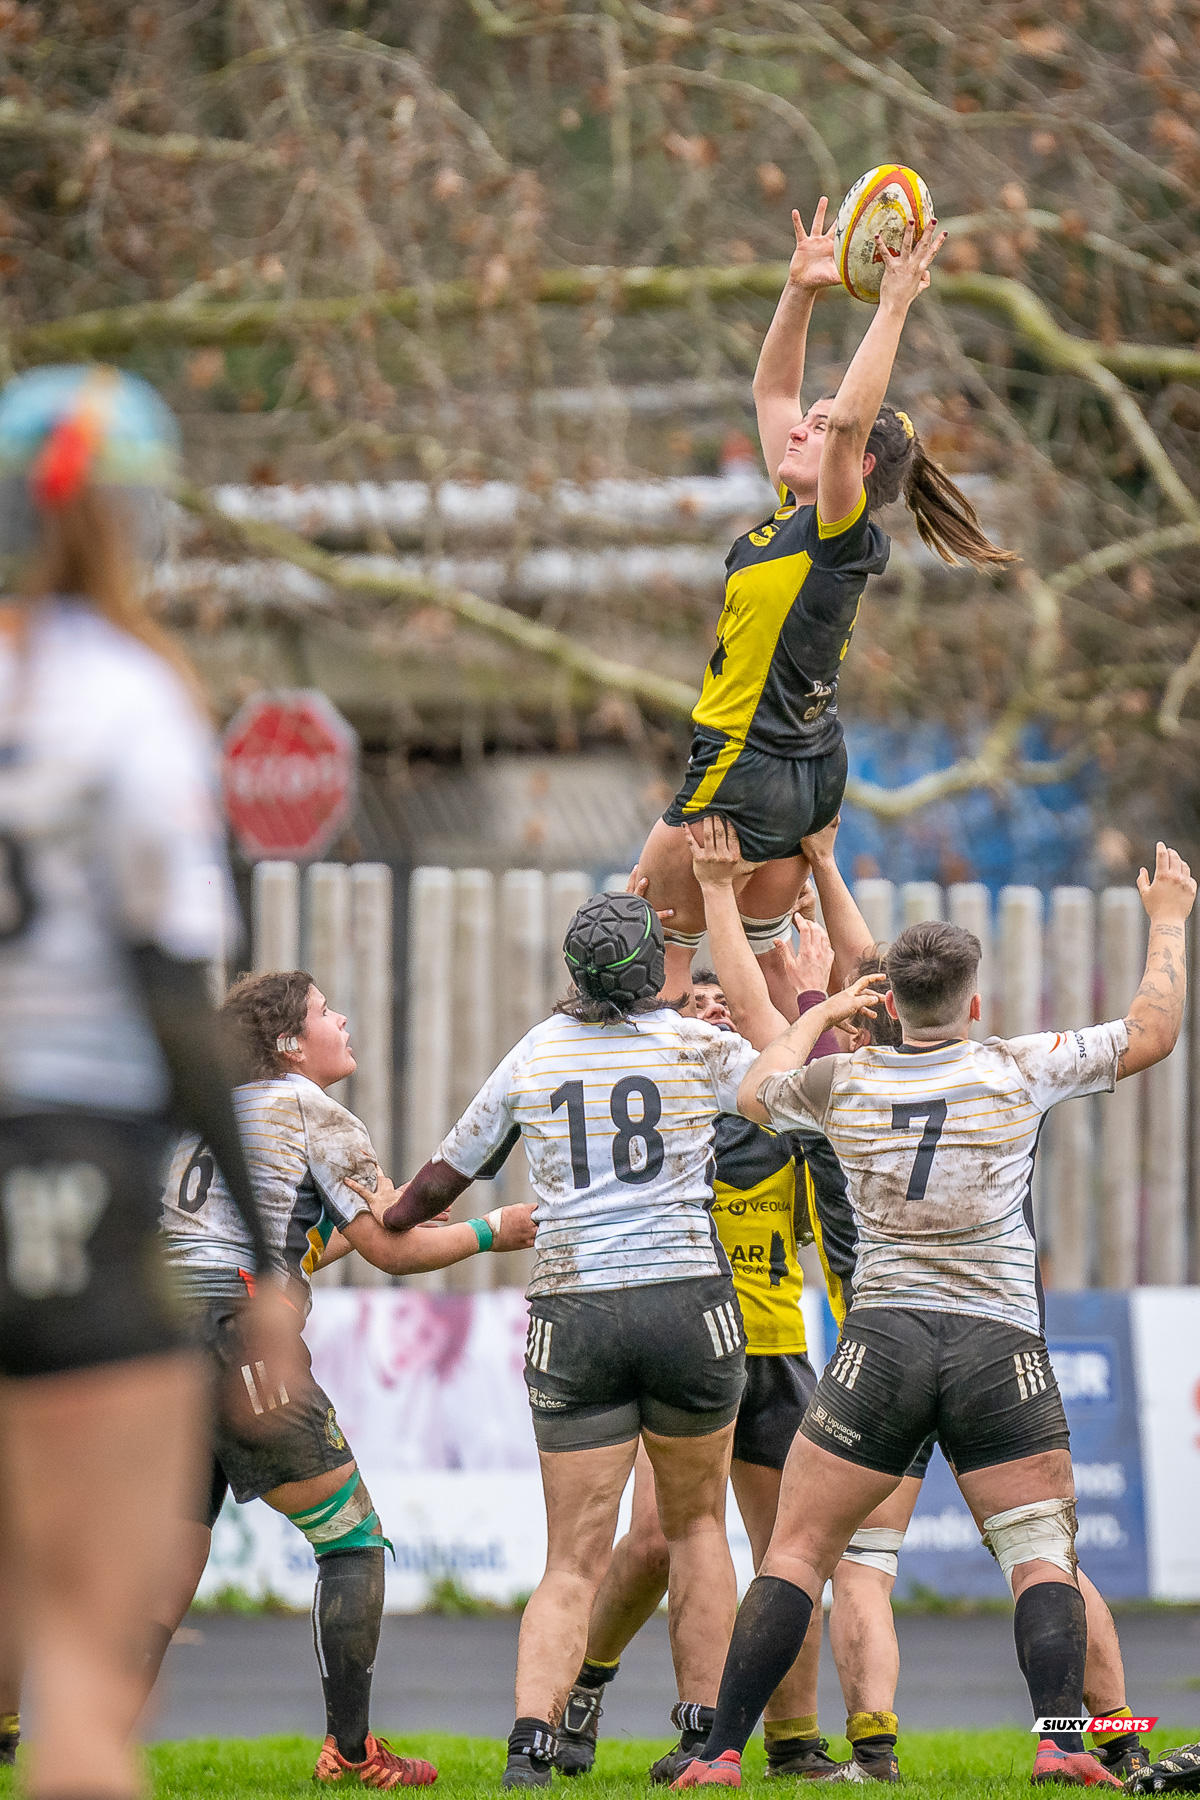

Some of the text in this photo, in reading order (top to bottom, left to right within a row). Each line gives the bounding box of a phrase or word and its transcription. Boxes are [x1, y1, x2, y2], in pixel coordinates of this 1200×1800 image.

[550, 1075, 665, 1190] 18
[891, 1098, 948, 1201] 7
[177, 1143, 215, 1214] 6
[749, 1201, 791, 1212] VEOLIA
